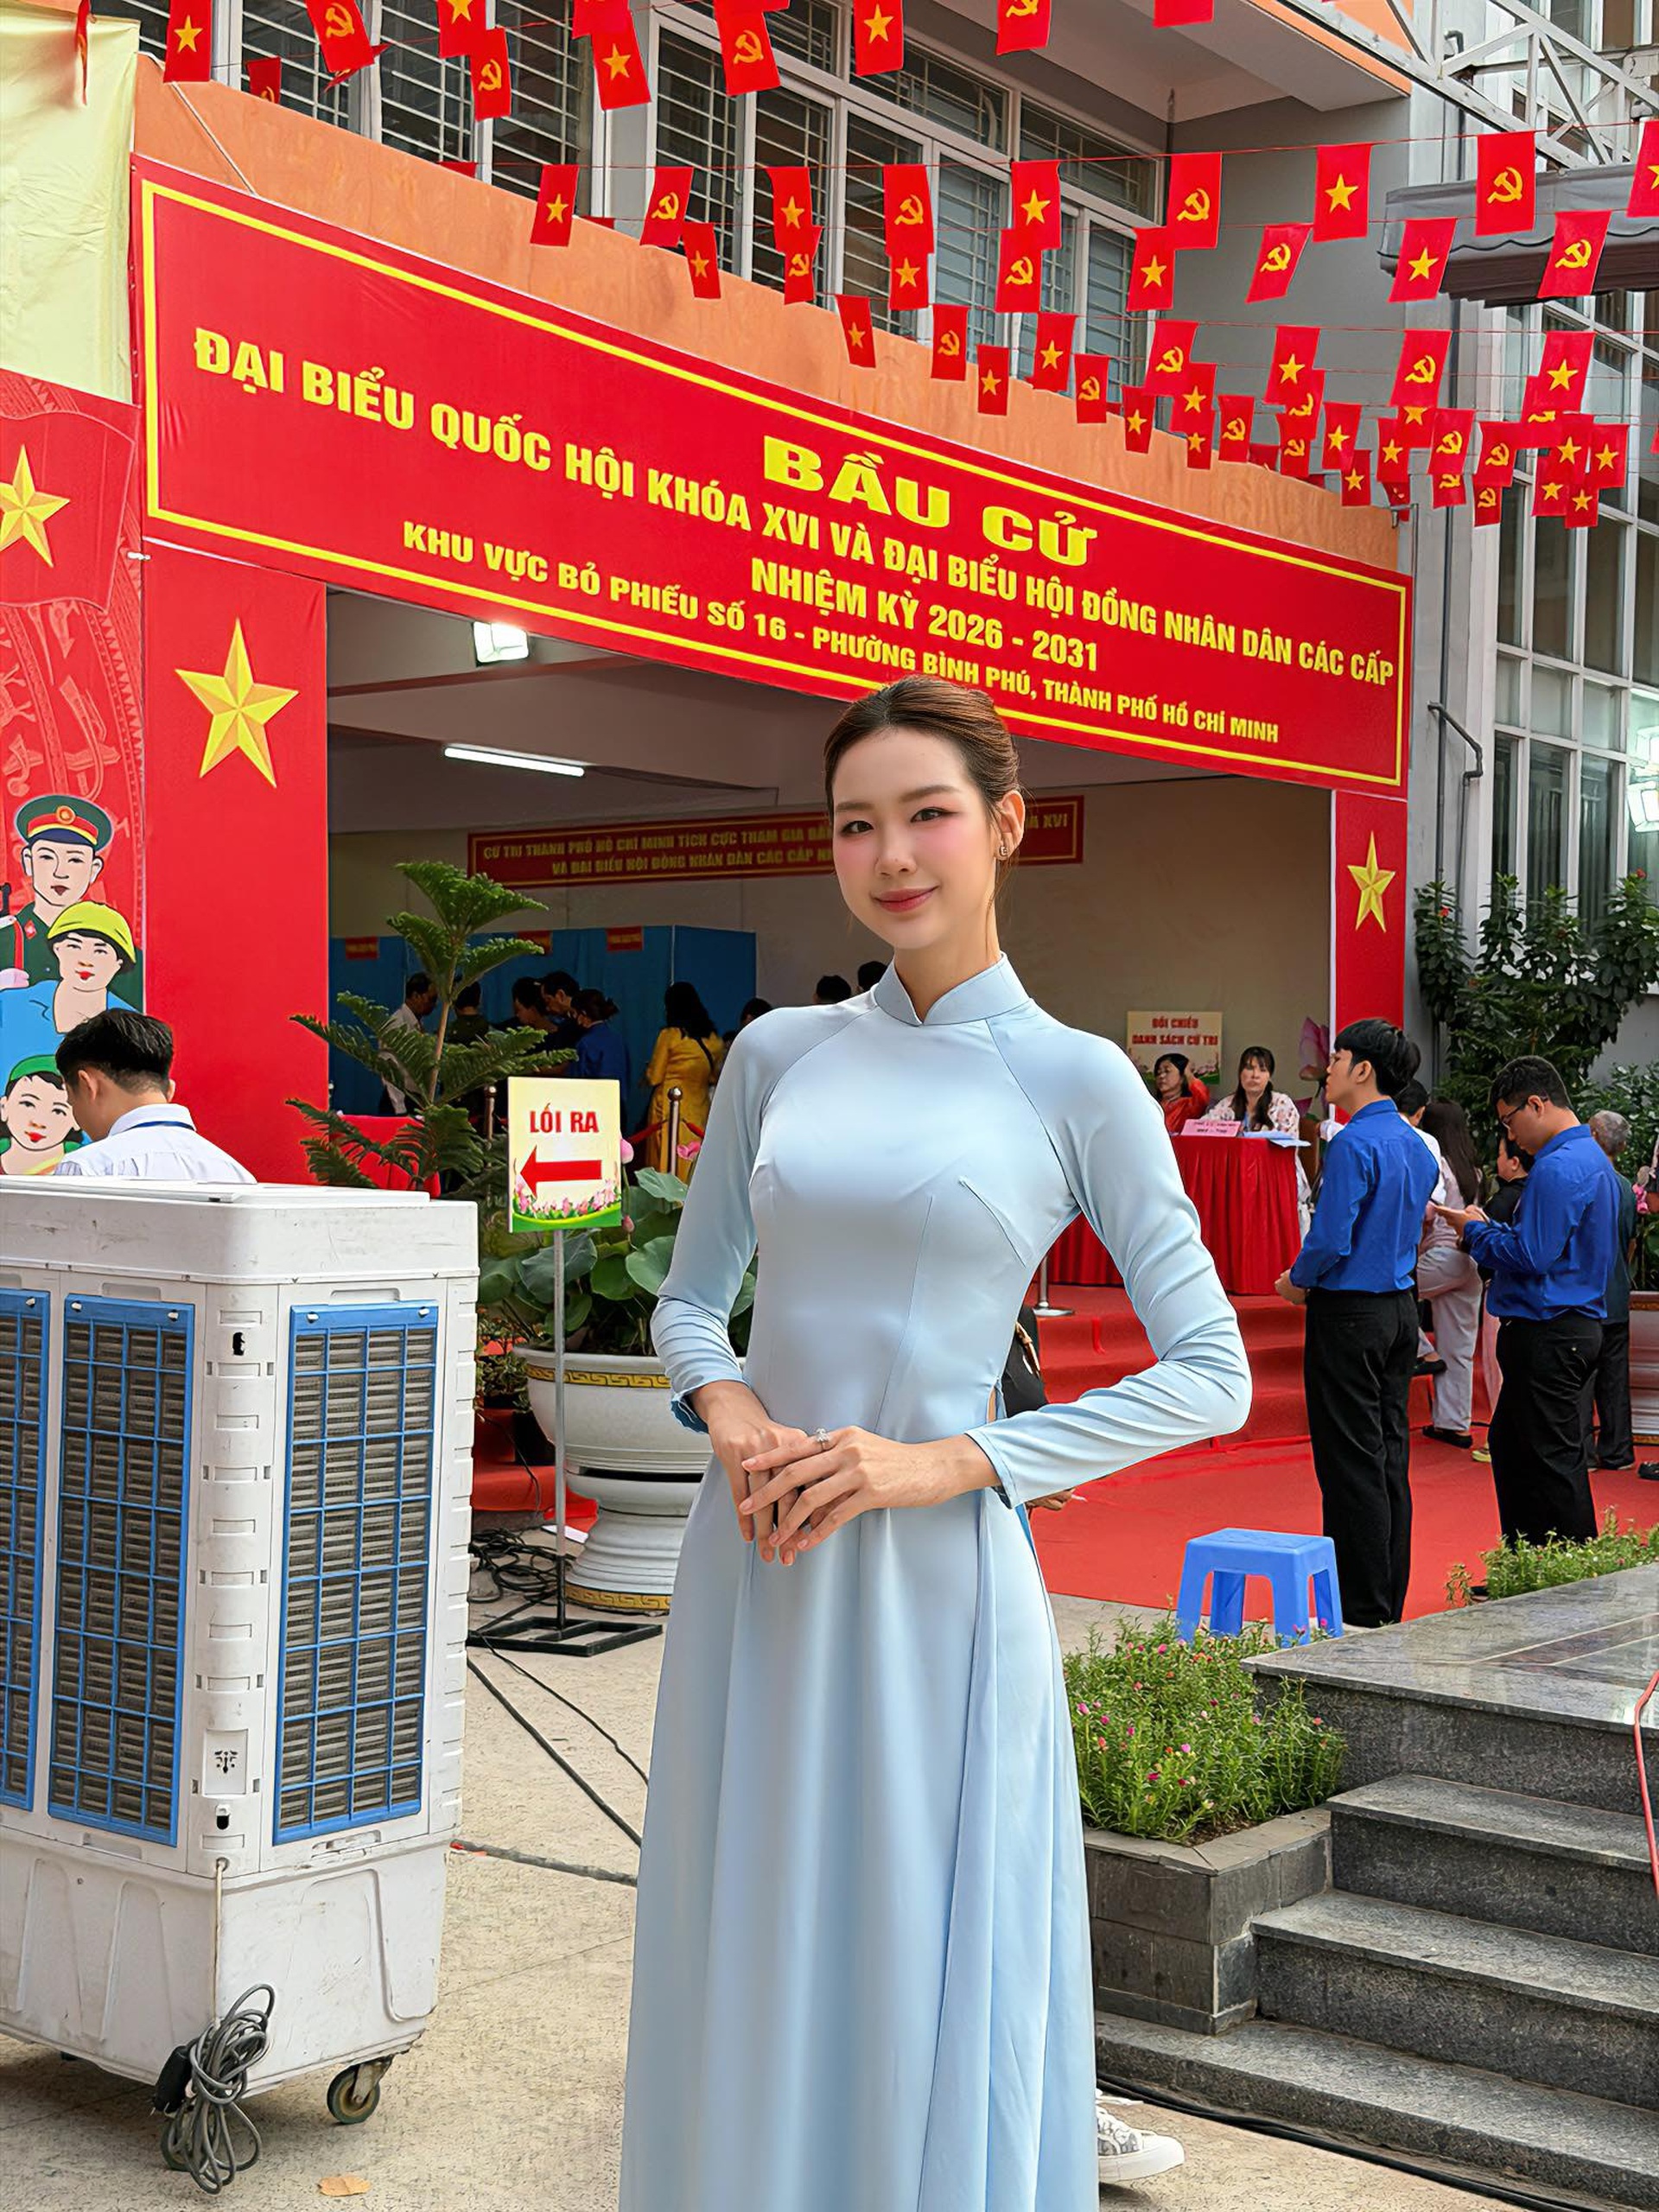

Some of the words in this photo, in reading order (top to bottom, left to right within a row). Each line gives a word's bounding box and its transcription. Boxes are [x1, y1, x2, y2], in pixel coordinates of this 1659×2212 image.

[193, 327, 284, 395] ĐẠI
[302, 360, 415, 430] BIỂU
[430, 404, 551, 471] QUỐC
[565, 442, 634, 500] HỘI
[647, 468, 752, 531] KHÓA
[761, 502, 820, 550] XVI
[830, 522, 874, 565] VÀ
[882, 537, 938, 584] ĐẠI
[947, 554, 1017, 601] BIỂU
[1026, 575, 1074, 619] HỘI
[1081, 588, 1157, 635] ĐỒNG
[1164, 611, 1236, 653] NHÂN
[1242, 627, 1292, 665] DÂN
[1298, 639, 1344, 677] CÁC
[1351, 649, 1394, 686] CẤP
[764, 435, 950, 528] BẦU
[982, 506, 1097, 567] CỬ
[403, 520, 474, 563] KHU
[483, 542, 549, 582] VỰC
[557, 562, 601, 596] BỎ
[609, 576, 699, 620] PHIẾU
[707, 600, 746, 632] SỐ
[753, 613, 787, 641] 16
[812, 626, 916, 671] PHƯỜNG
[922, 652, 980, 685] BÌNH
[985, 665, 1037, 700] PHÚ,
[1042, 678, 1112, 713] THÀNH
[1116, 694, 1158, 721] PHỐ
[1193, 709, 1225, 734] CHÍ
[1230, 716, 1279, 743] MINH
[751, 556, 867, 619] NHIỆM
[877, 588, 919, 630] KỲ
[928, 604, 1003, 650] 2026
[1012, 638, 1023, 646] -
[1032, 629, 1097, 672] 2031
[1043, 813, 1068, 829] XVI
[1132, 1034, 1157, 1045] DANH
[1202, 1034, 1218, 1046] TRI
[569, 1110, 600, 1134] RA
